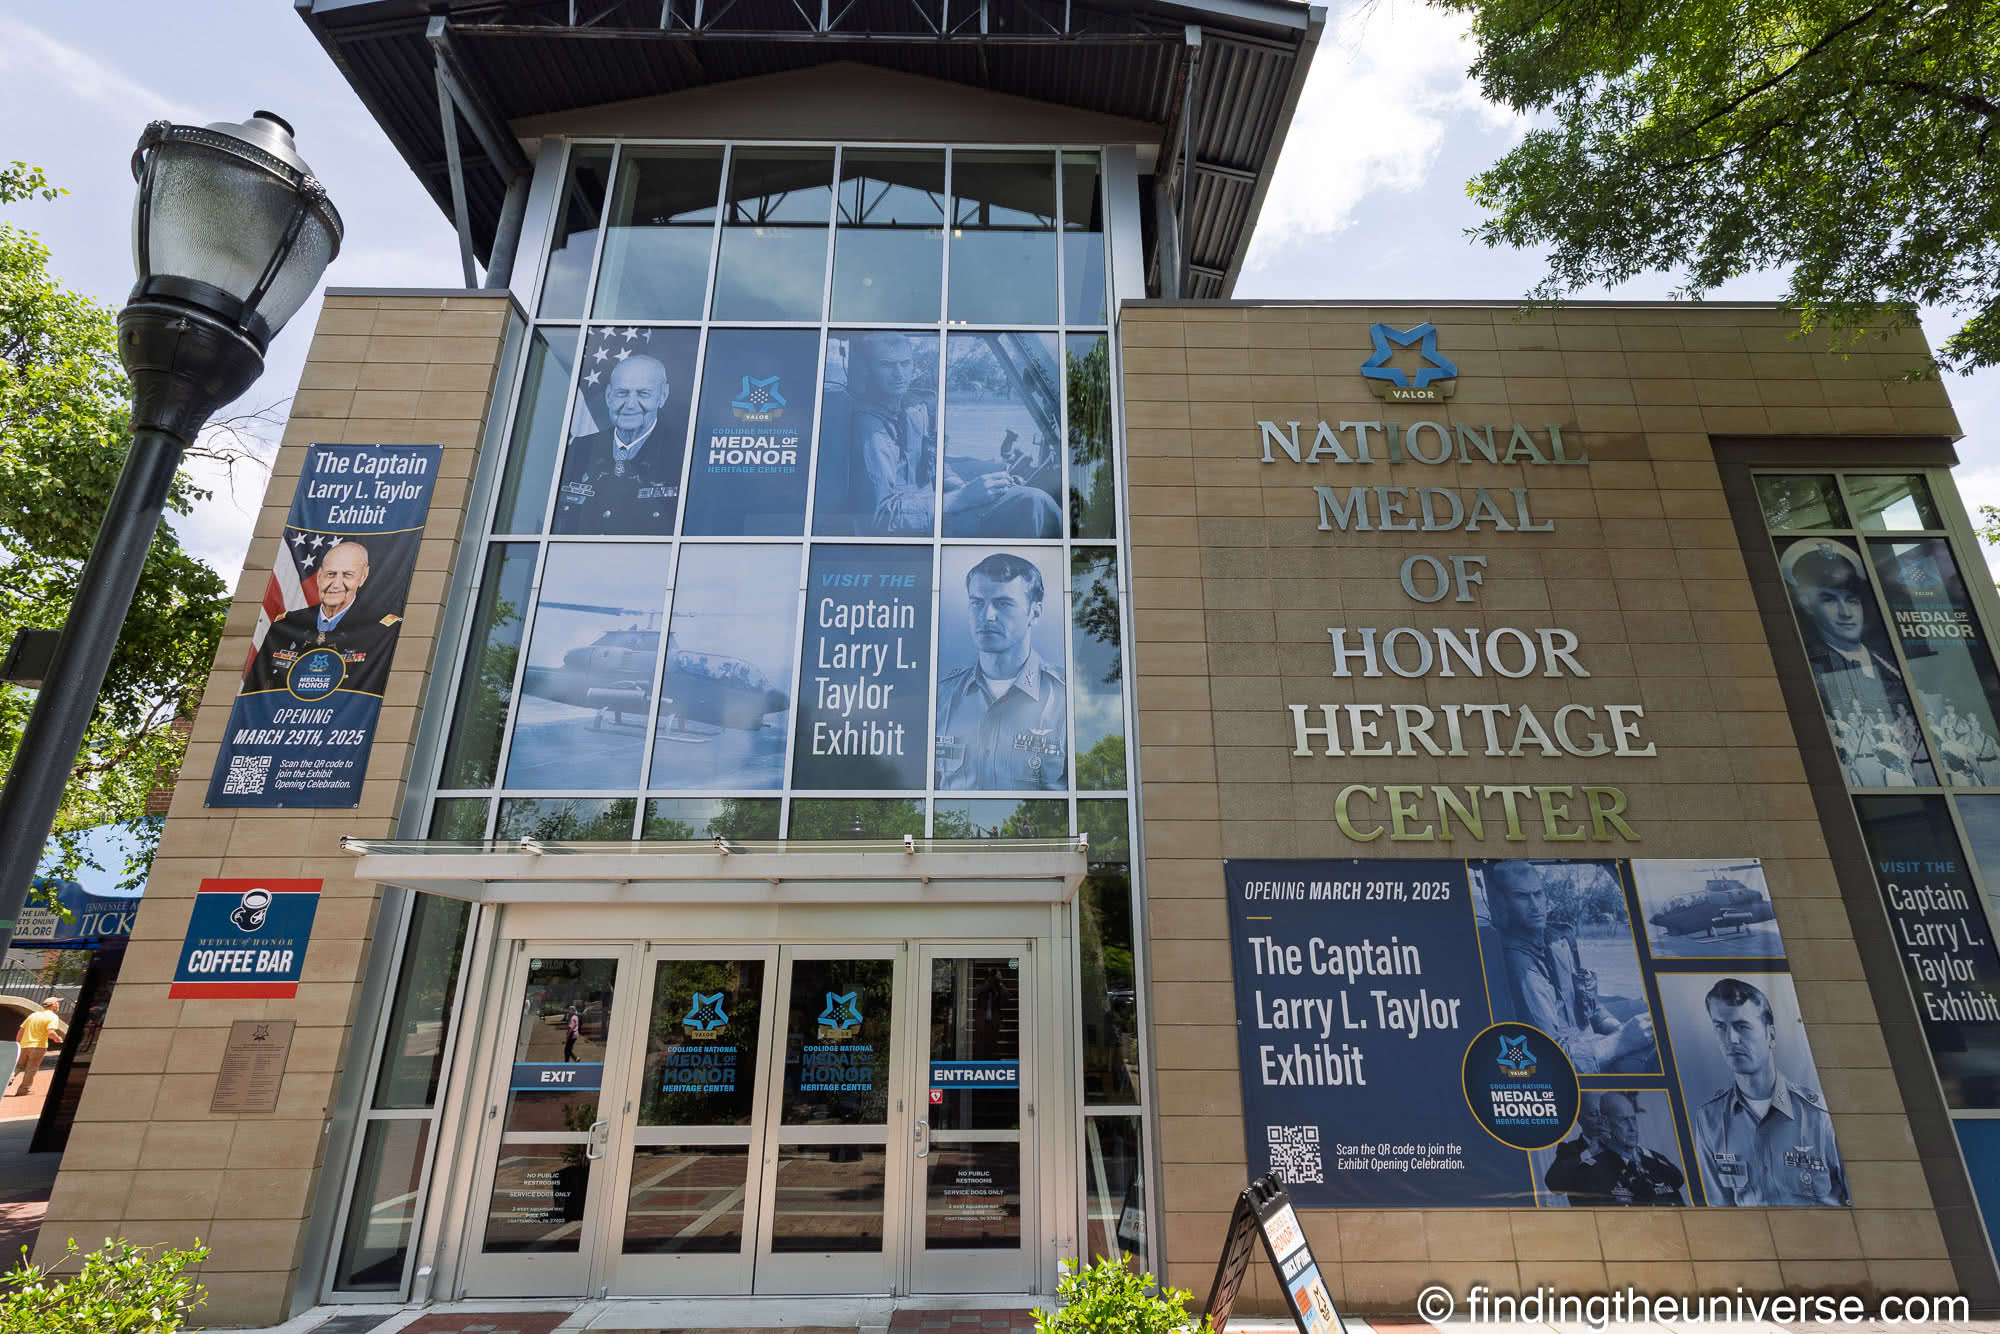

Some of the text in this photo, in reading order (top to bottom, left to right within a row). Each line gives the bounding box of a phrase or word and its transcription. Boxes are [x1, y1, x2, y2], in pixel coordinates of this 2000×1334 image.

[1392, 390, 1435, 399] VALOR
[710, 436, 798, 449] MEDAL OF
[1257, 420, 1589, 465] NATIONAL
[708, 449, 797, 465] HONOR
[315, 452, 428, 479] The Captain
[307, 480, 424, 503] Larry L. Taylor
[327, 505, 386, 525] Exhibit
[1313, 486, 1555, 532] MEDAL
[821, 574, 918, 587] VISIT THE
[1399, 555, 1488, 603] OF
[819, 597, 915, 636] Captain
[1895, 611, 1968, 623] MEDAL OF
[1899, 624, 1976, 638] HONOR
[818, 636, 917, 677] Larry L.
[1327, 627, 1591, 678] HONOR
[815, 676, 894, 718] Taylor
[272, 709, 334, 724] OPENING
[233, 729, 365, 746] MARCH 29TH, 2025
[812, 721, 905, 756] Exhibit
[1288, 703, 1657, 758] HERITAGE
[279, 759, 299, 767] Scan
[299, 759, 313, 767] the
[313, 759, 325, 768] QR
[275, 769, 333, 780] join the Exhibit
[274, 780, 351, 790] Opening Celebration.
[1334, 784, 1642, 842] CENTER
[1879, 861, 1956, 873] VISIT THE
[1244, 881, 1450, 902] OPENING MARCH 29TH, 2025
[1888, 882, 1969, 917] Captain
[199, 938, 238, 946] MEDAL
[252, 938, 294, 946] HONOR
[1899, 917, 1985, 953] Larry L.
[187, 950, 294, 973] COFFEE BAR
[1248, 936, 1421, 985] The Captain
[1908, 952, 1976, 989] Taylor
[1923, 991, 2000, 1021] Exhibit
[1255, 989, 1461, 1040] Larry L. Taylor
[666, 1055, 722, 1066] MEDAL
[802, 1053, 855, 1065] MEDAL
[1259, 1043, 1366, 1086] Exhibit
[540, 1071, 577, 1083] EXIT
[664, 1068, 737, 1083] HONOR
[801, 1067, 873, 1081] HONOR
[934, 1069, 1016, 1081] ENTRANCE
[662, 1084, 735, 1092] HERITAGE CENTER
[800, 1083, 872, 1091] HERITAGE CENTER
[1490, 1091, 1554, 1102] MEDAL OF
[1493, 1103, 1558, 1117] HONOR
[1336, 1143, 1462, 1157] Scan the QR code to join the
[1337, 1157, 1465, 1172] Exhibit Opening Celebration.
